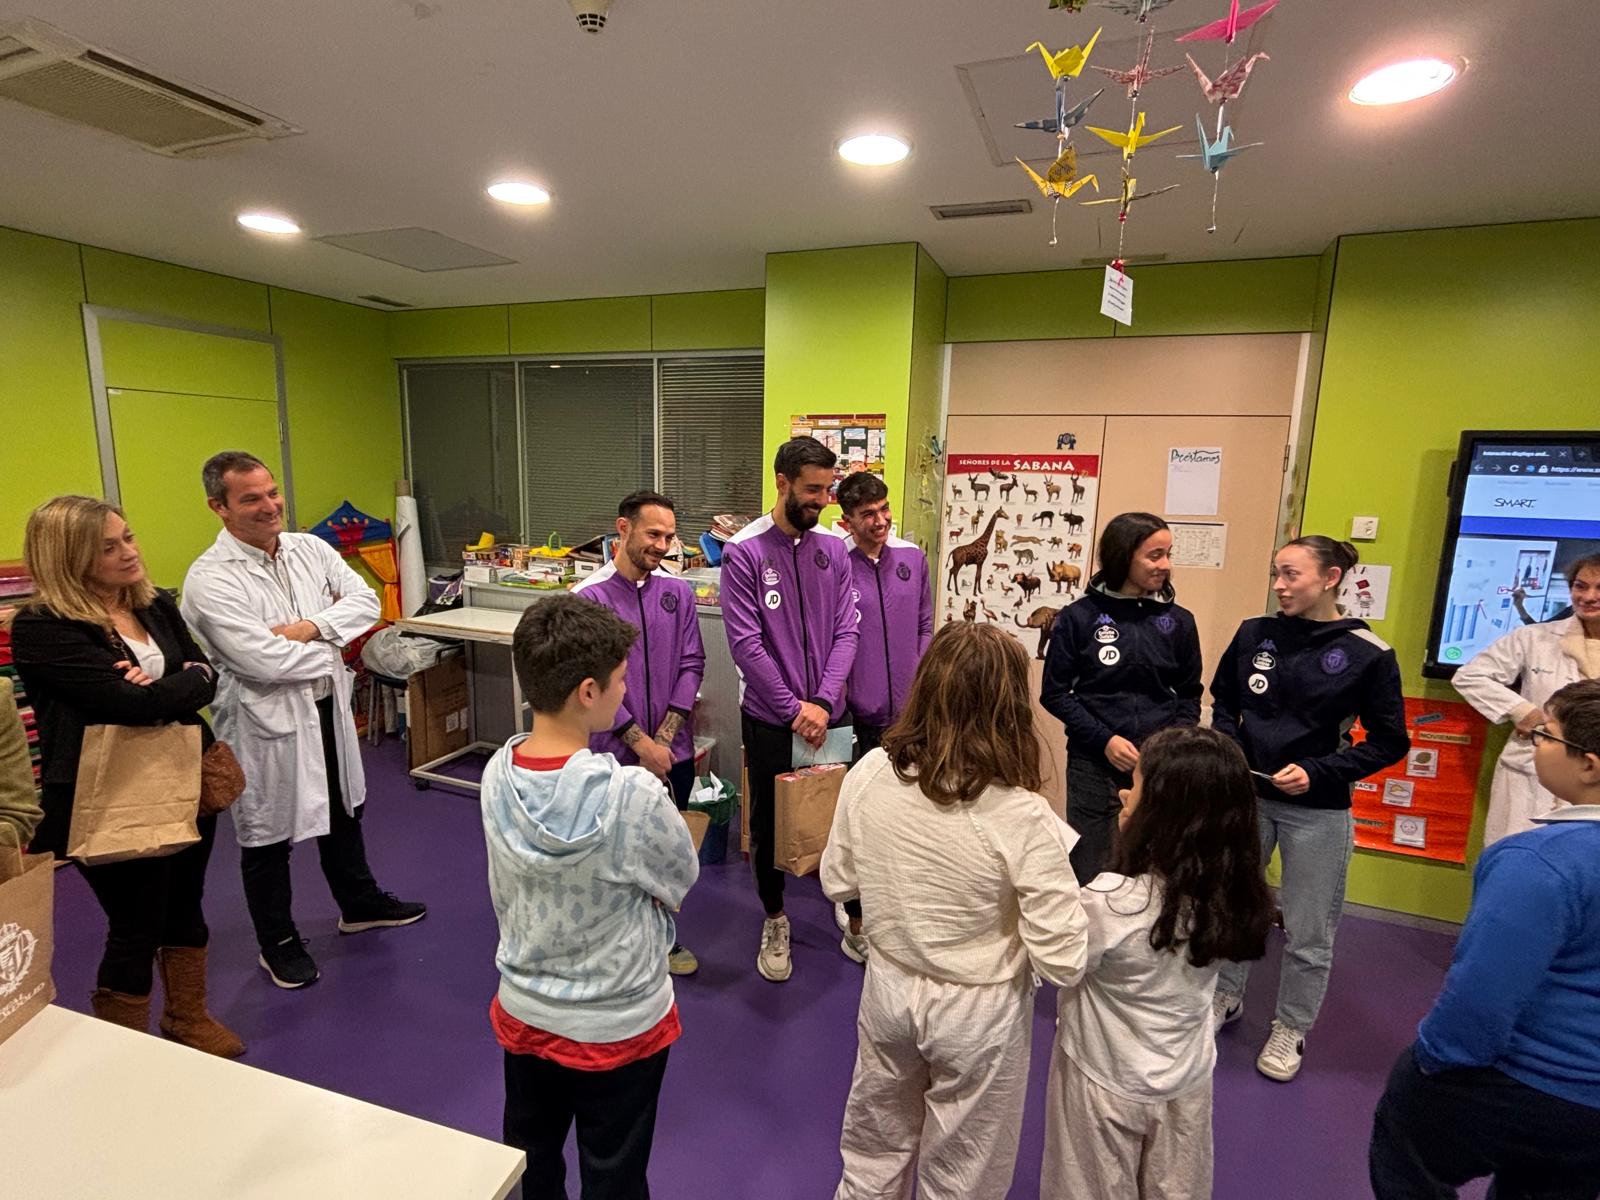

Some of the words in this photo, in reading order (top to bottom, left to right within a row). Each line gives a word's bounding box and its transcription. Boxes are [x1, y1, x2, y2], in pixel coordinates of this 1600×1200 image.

[959, 458, 989, 466] SEÑORES
[1013, 459, 1075, 471] SABANA
[768, 594, 778, 605] JD
[1102, 650, 1117, 660] JD
[1252, 679, 1265, 689] JD
